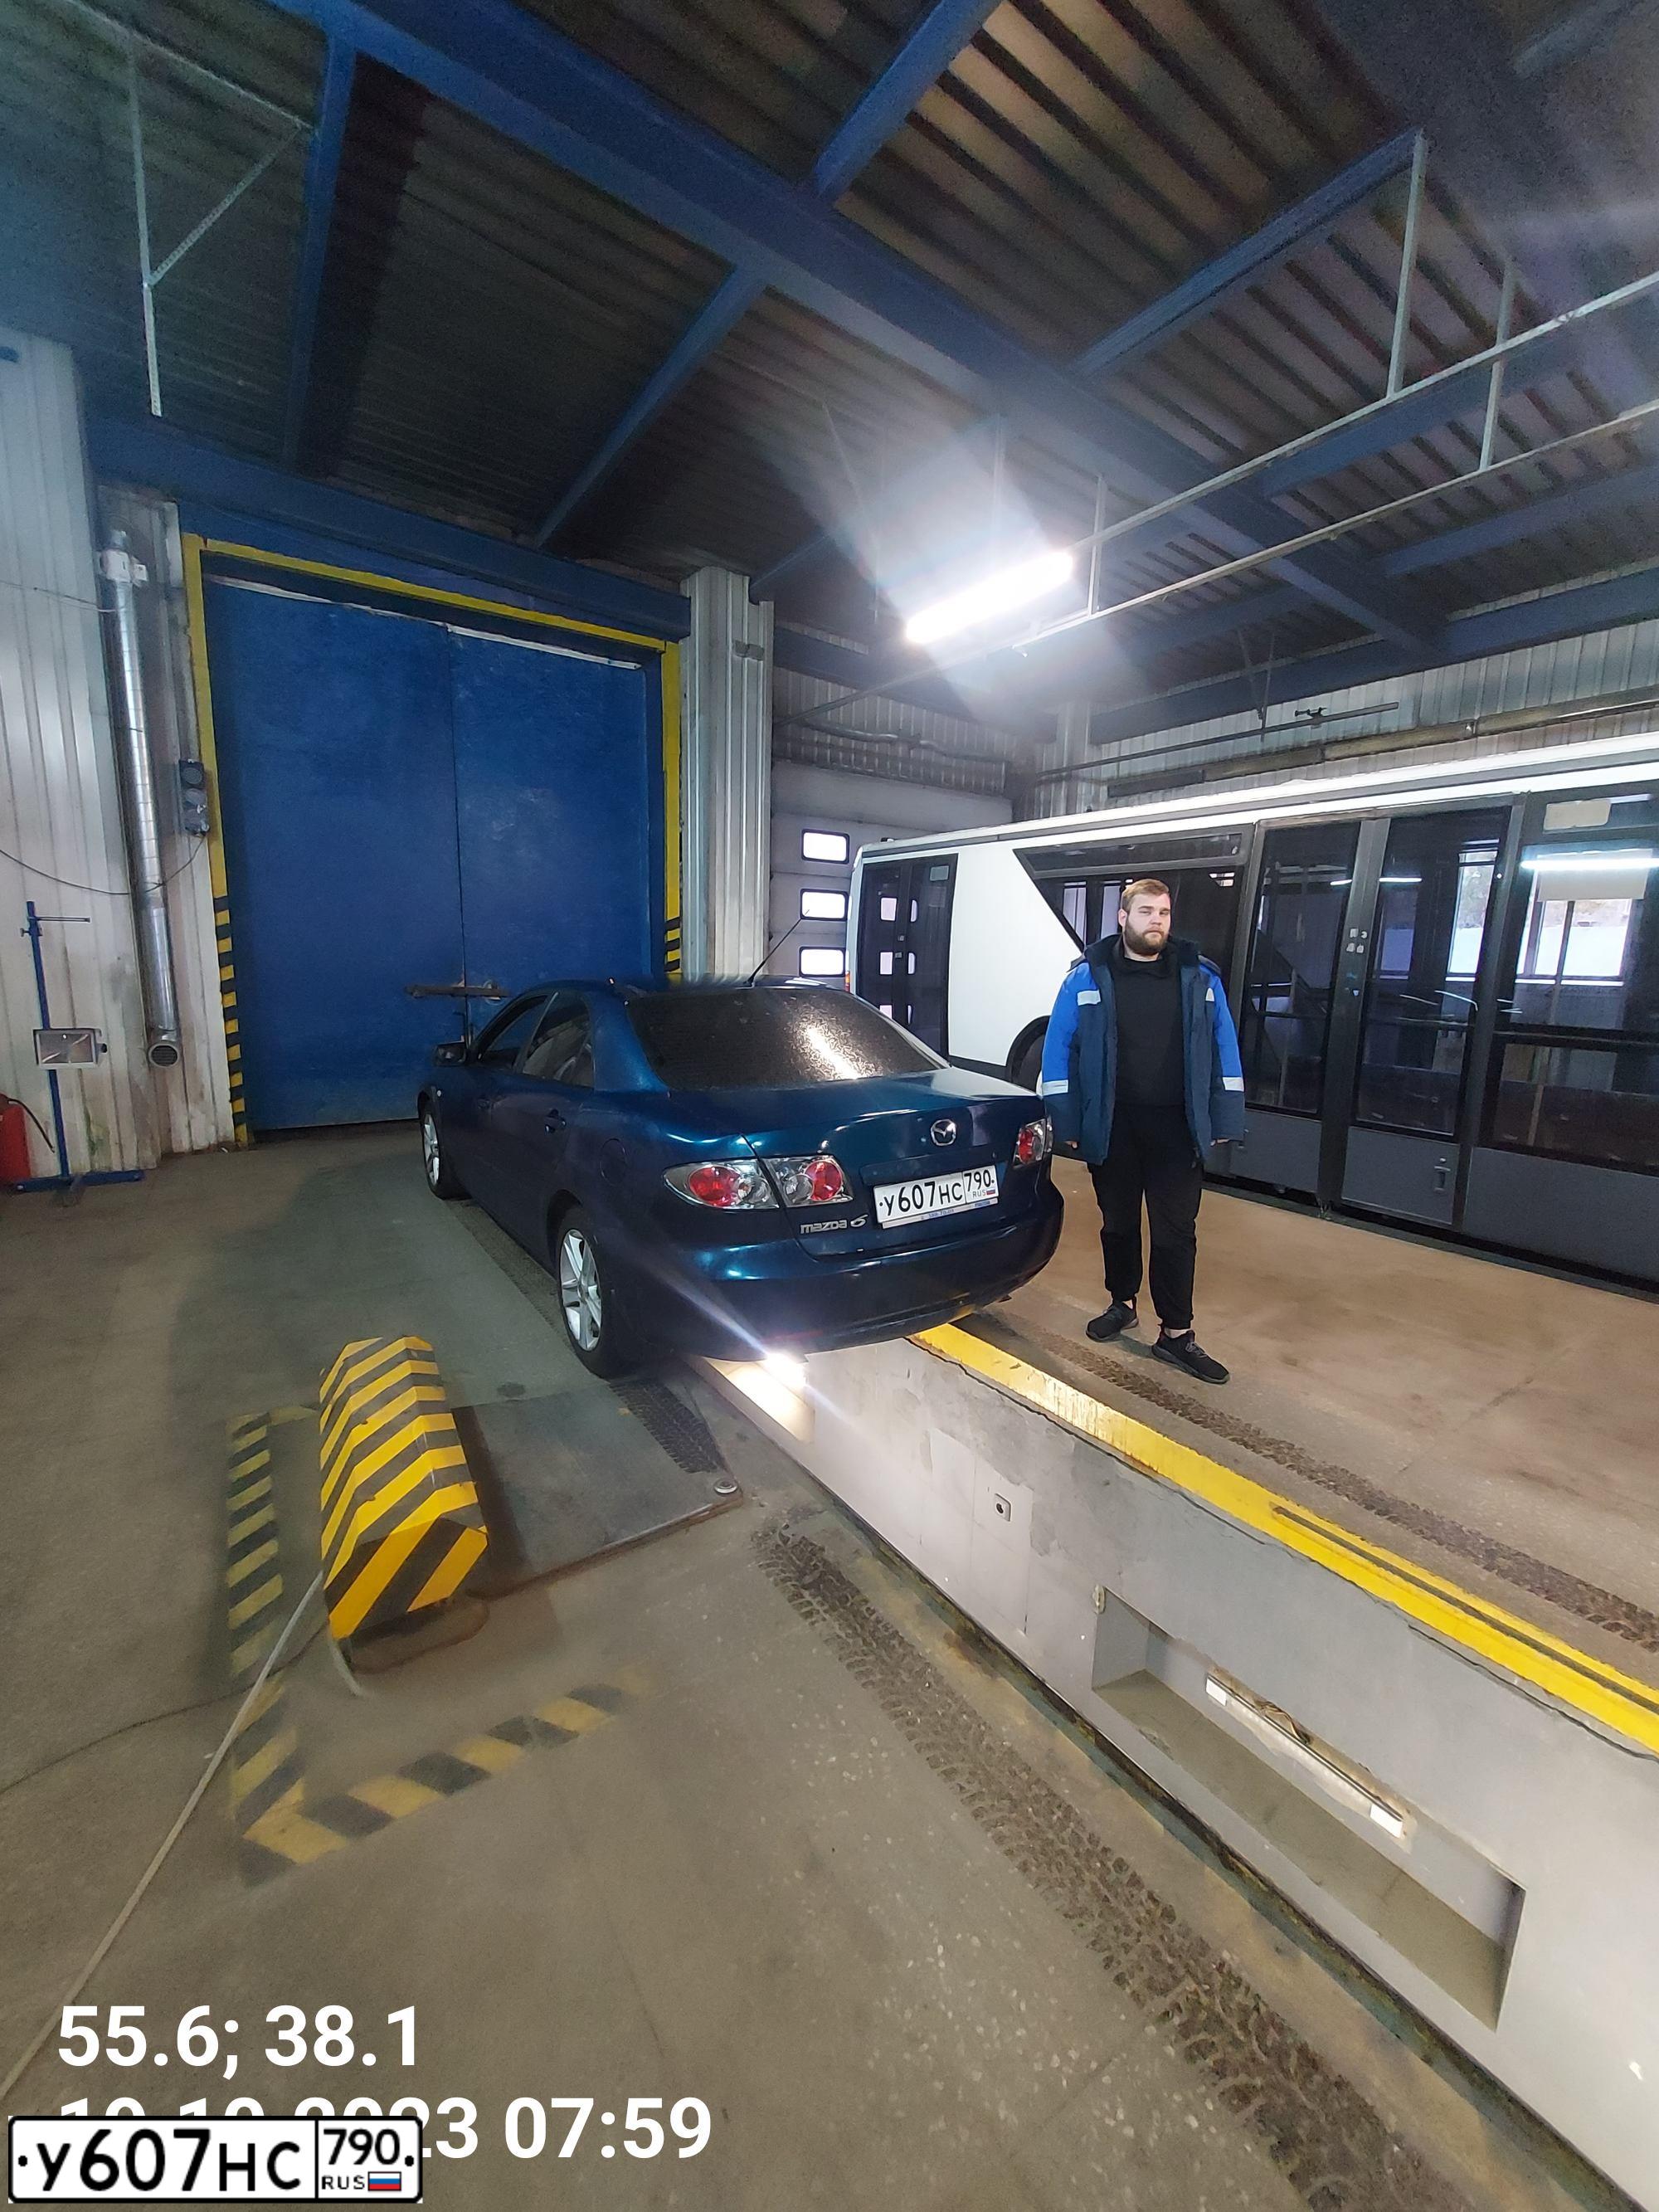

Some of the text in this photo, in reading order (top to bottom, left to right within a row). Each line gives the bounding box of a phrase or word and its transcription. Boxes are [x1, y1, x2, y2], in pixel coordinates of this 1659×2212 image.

[963, 1169, 992, 1192] 790
[972, 1190, 986, 1198] RUS
[850, 1214, 868, 1228] 6
